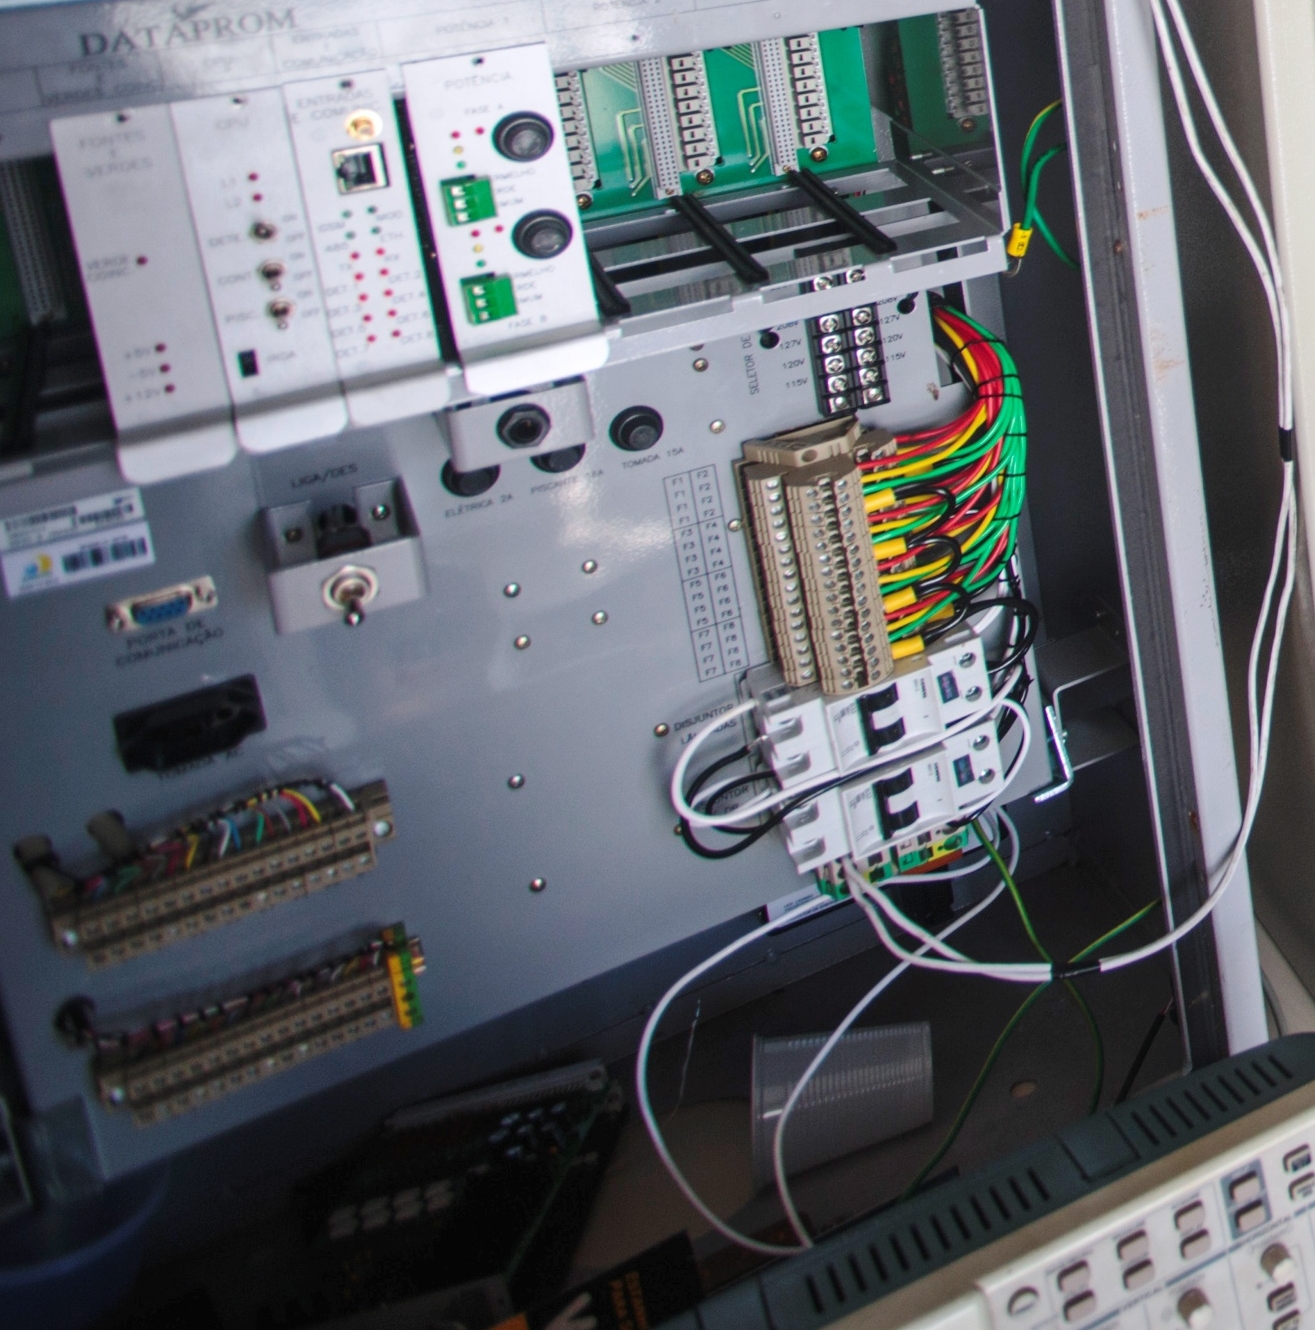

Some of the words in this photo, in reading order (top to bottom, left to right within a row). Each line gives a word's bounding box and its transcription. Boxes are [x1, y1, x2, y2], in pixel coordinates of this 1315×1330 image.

[80, 7, 299, 57] DATAPROM
[779, 338, 802, 350] 127V
[782, 358, 806, 370] 120V
[743, 353, 760, 395] SELETOR
[786, 378, 809, 389] 115V
[622, 453, 661, 469] TOMADA
[530, 474, 579, 495] PISCANTE
[671, 477, 684, 487] F1
[675, 490, 686, 499] F1
[445, 498, 495, 518] ELÉTRICA
[677, 503, 688, 512] F1
[681, 529, 693, 538] F3
[683, 542, 695, 551] F3
[685, 554, 698, 563] F3
[687, 567, 700, 576] F3
[698, 629, 710, 639] F7
[701, 642, 712, 651] F7
[703, 655, 715, 664] F7
[705, 668, 717, 676] F7
